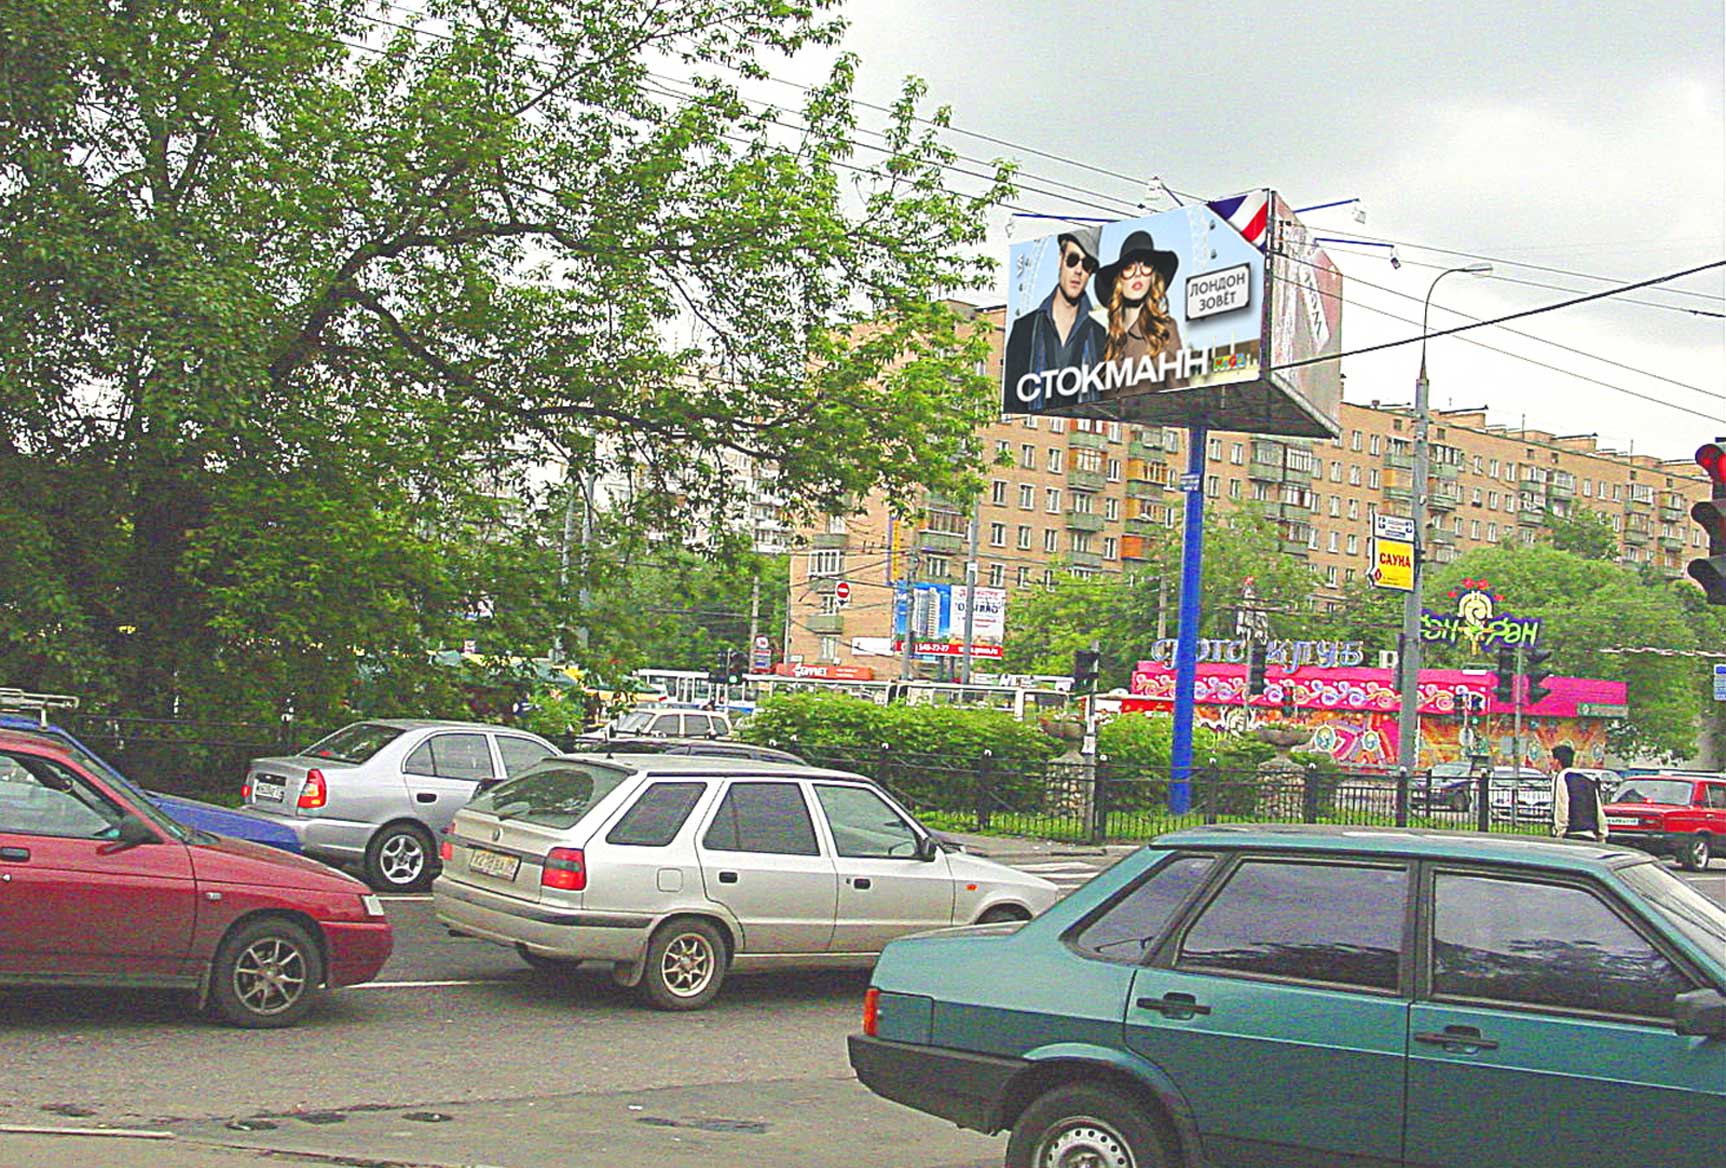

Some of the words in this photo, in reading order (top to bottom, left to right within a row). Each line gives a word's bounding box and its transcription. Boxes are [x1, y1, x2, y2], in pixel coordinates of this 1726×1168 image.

[1190, 272, 1246, 297] ЛОНДОН
[1016, 348, 1208, 403] СТОКМАНН
[1379, 552, 1412, 568] САУНА
